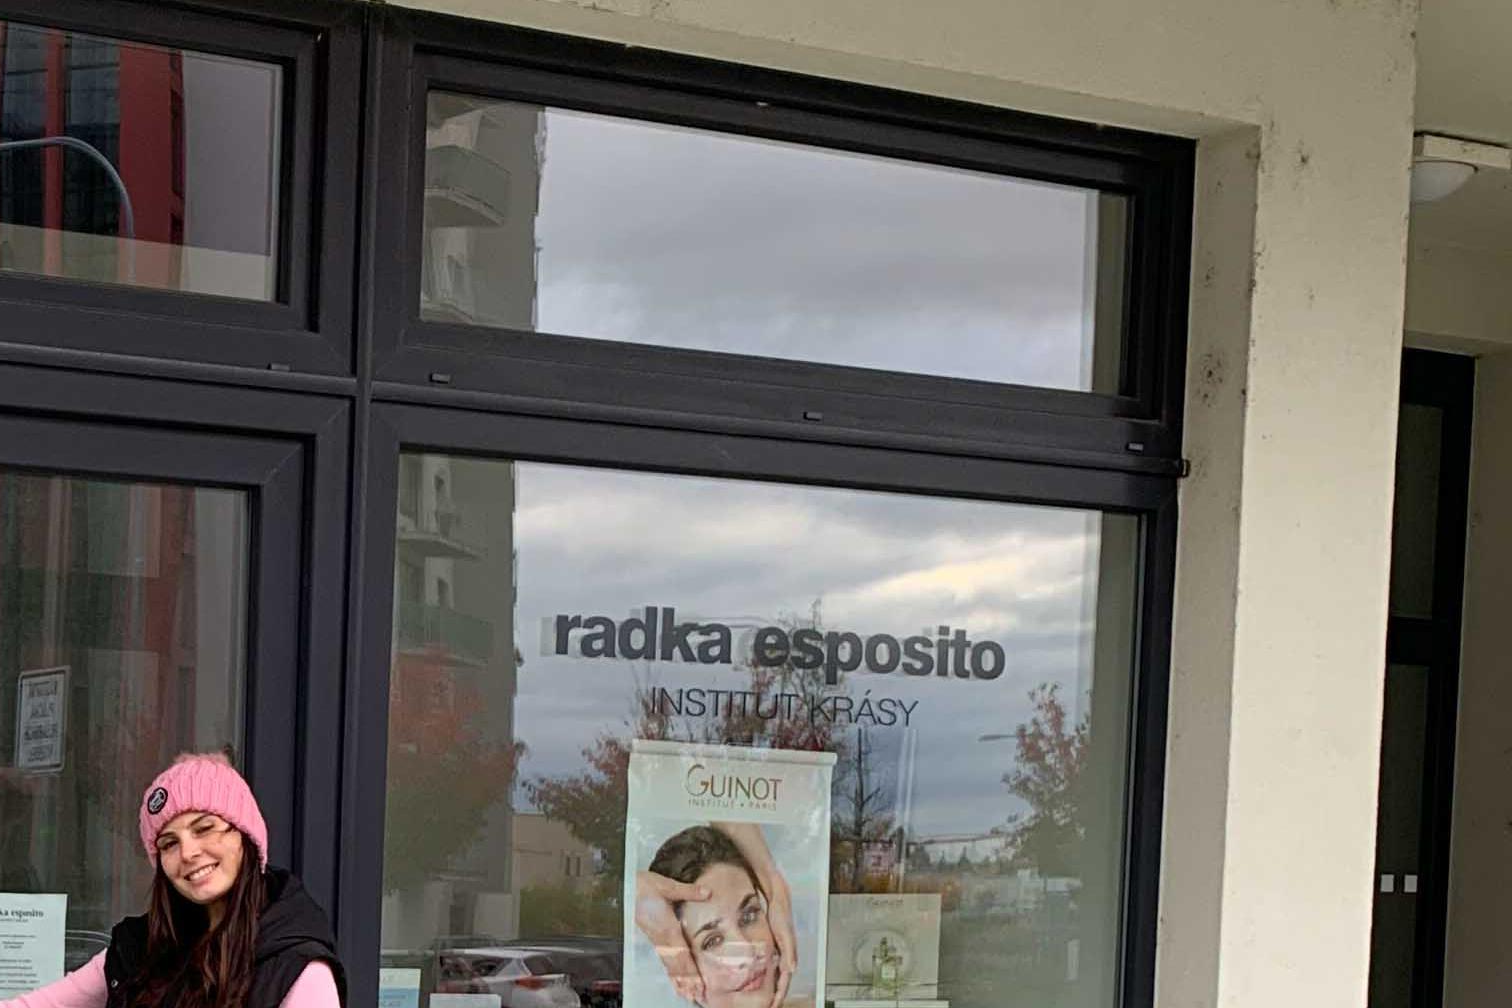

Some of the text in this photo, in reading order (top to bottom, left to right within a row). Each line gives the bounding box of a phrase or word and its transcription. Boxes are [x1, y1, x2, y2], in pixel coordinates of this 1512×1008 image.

[555, 606, 1007, 685] radka esposito
[651, 687, 919, 726] INSTITUT KRÁSY
